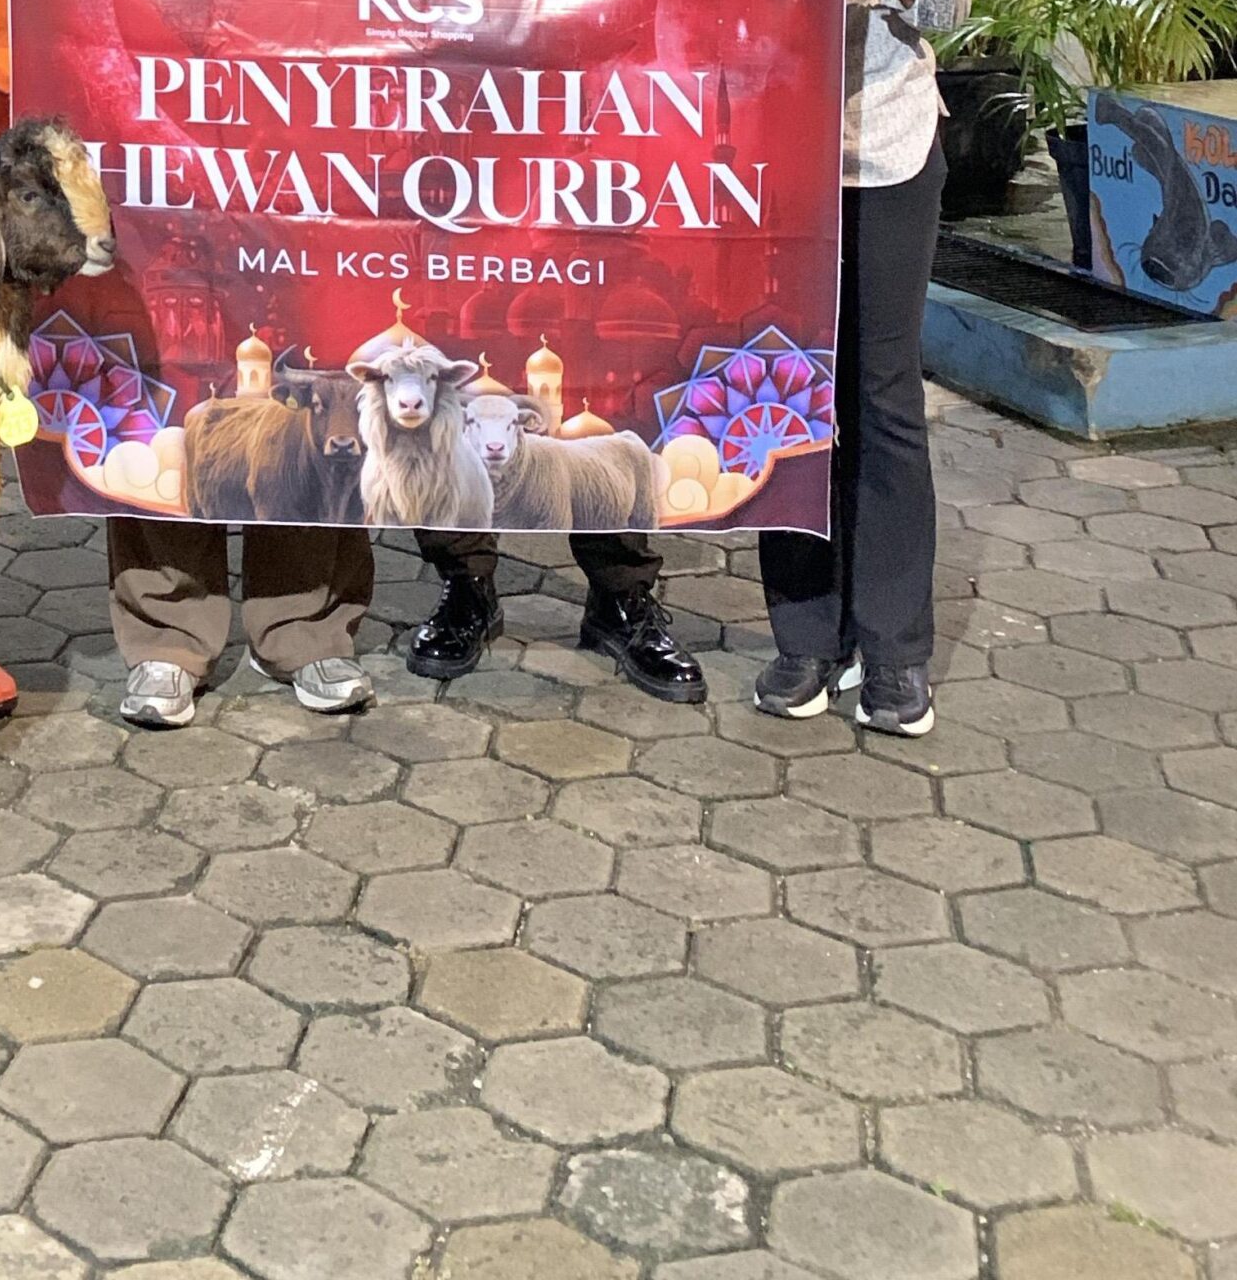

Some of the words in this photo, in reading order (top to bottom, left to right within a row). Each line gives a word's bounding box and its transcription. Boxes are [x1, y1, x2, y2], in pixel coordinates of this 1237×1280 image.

[430, 29, 473, 42] Shopping
[135, 55, 710, 138] PENYERAHAN
[1090, 143, 1134, 184] Budi
[82, 140, 386, 218] HEWAN
[402, 154, 769, 234] QURBAN
[238, 246, 319, 277] MAL
[337, 250, 410, 280] KCS
[427, 253, 606, 286] BERBAGI
